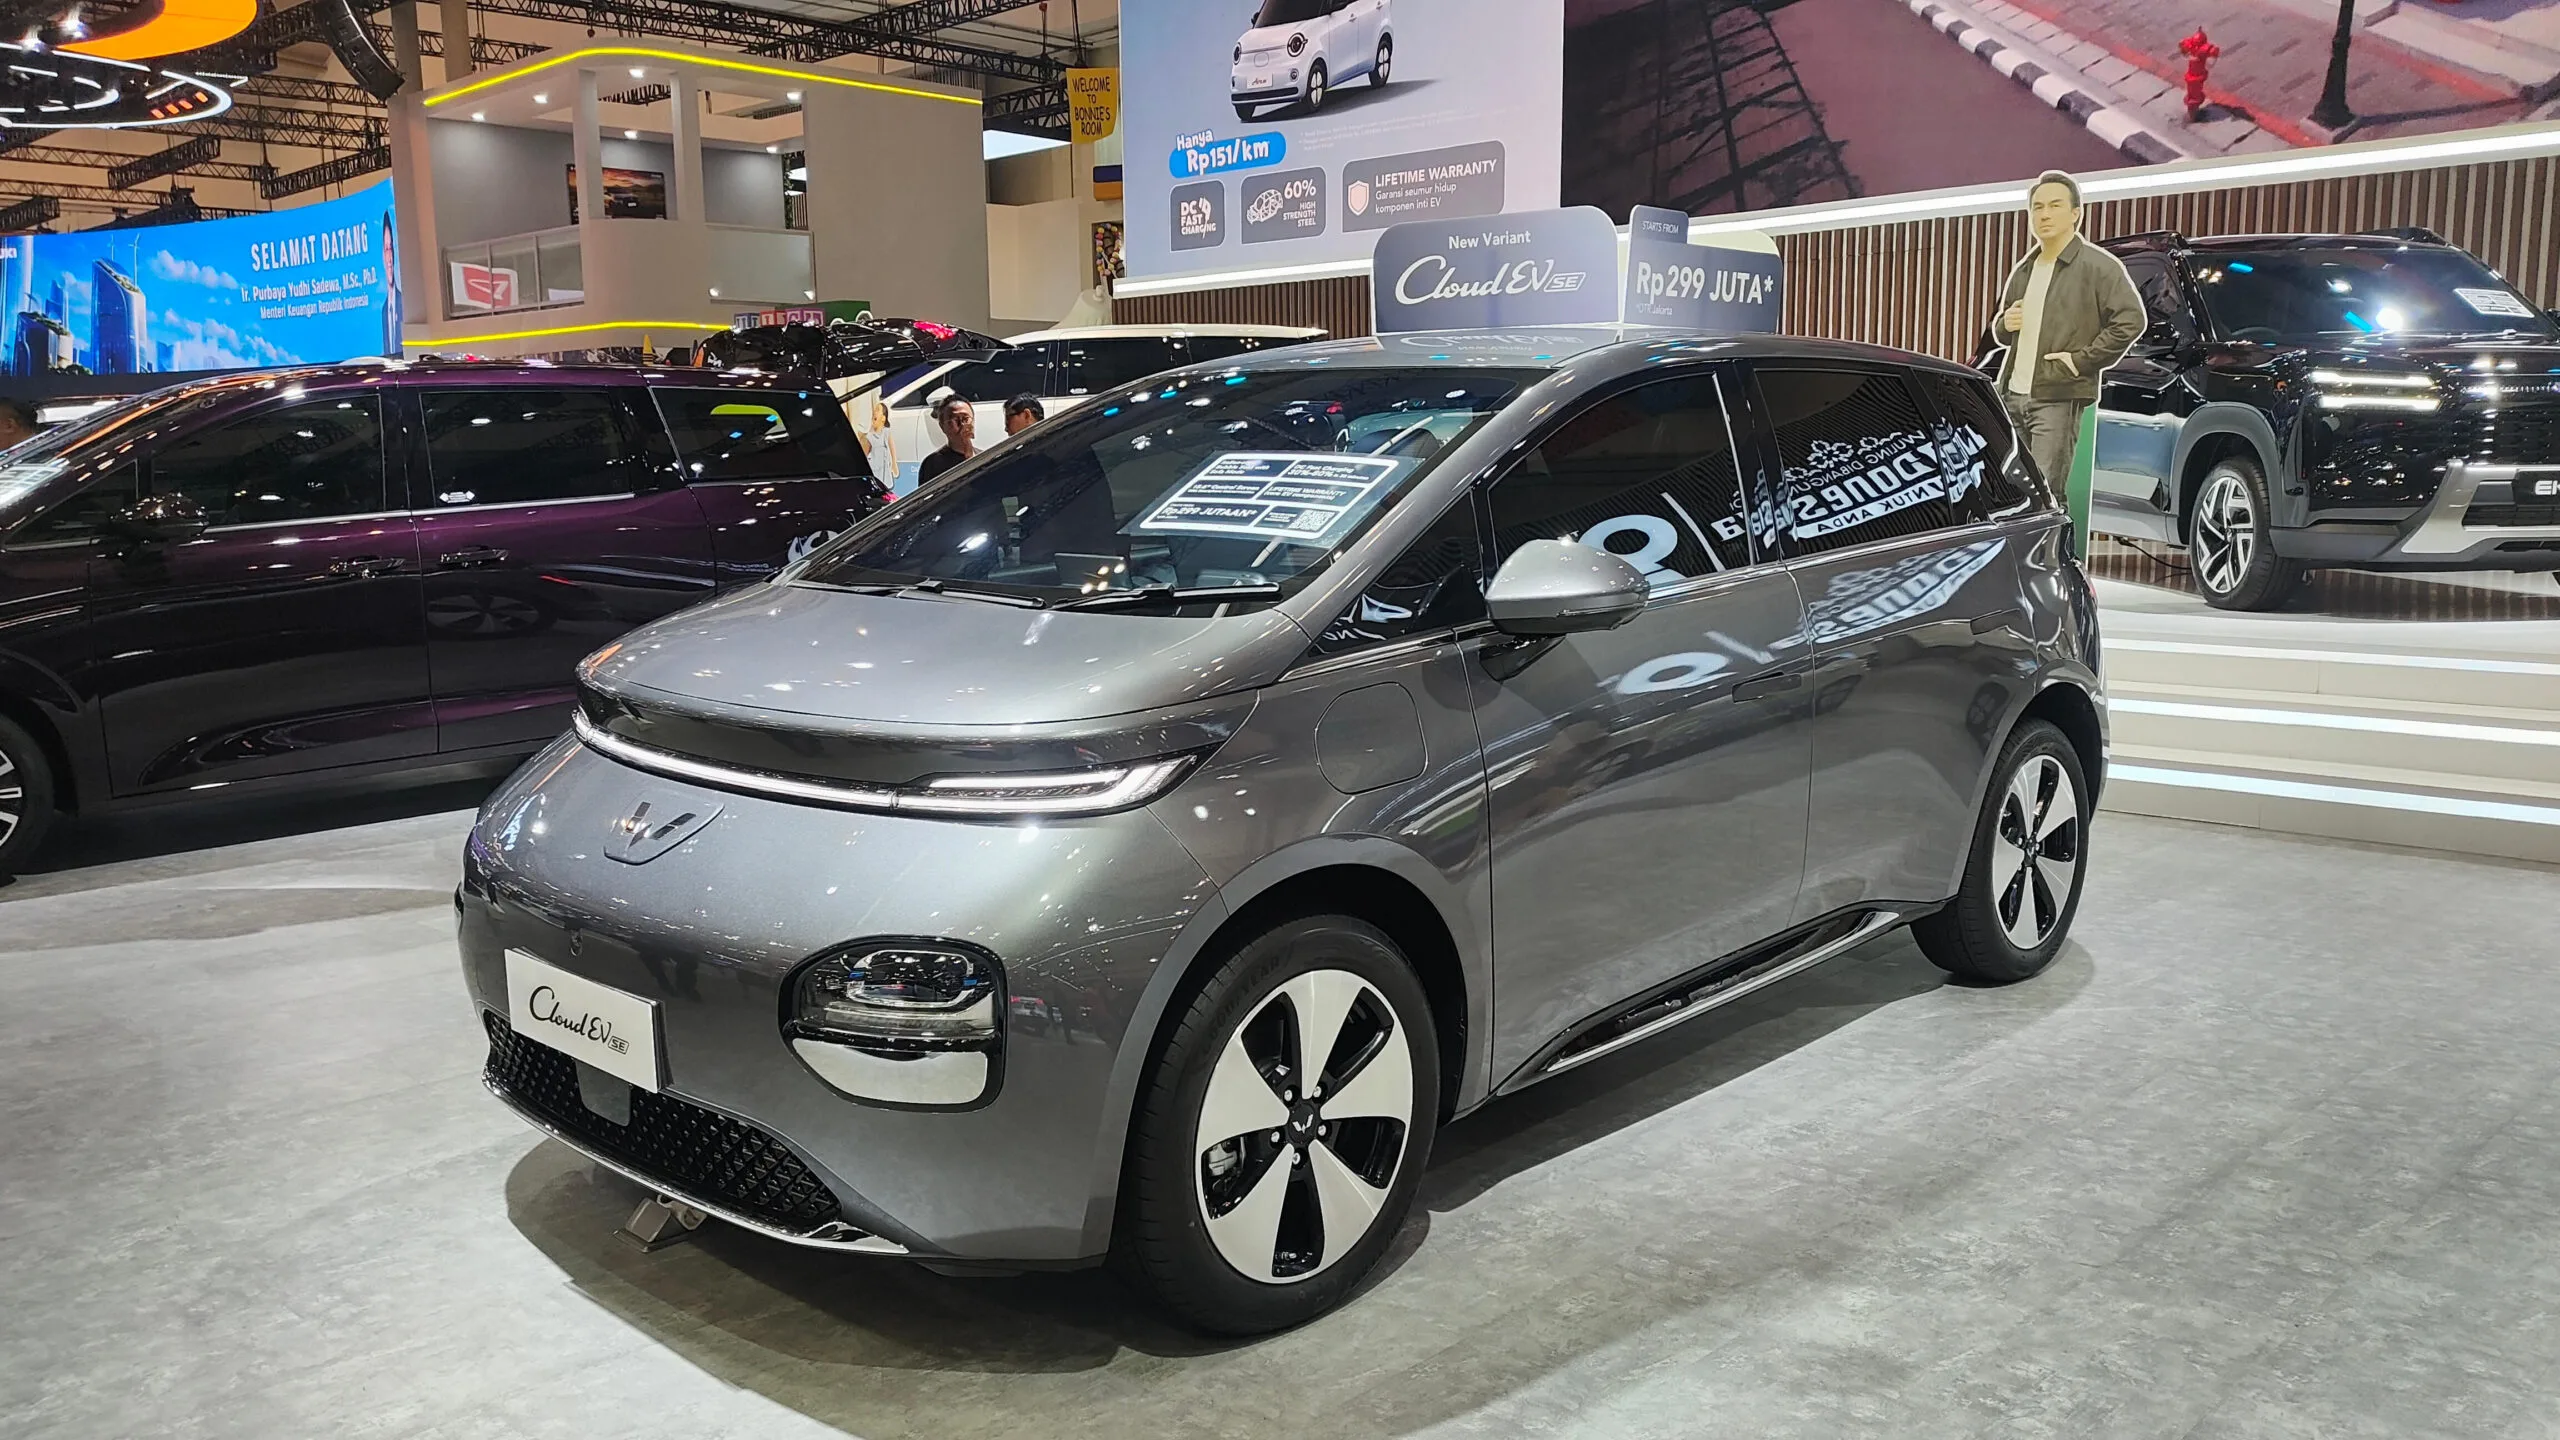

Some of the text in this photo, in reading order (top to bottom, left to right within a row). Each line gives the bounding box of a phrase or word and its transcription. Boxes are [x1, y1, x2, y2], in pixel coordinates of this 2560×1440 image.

[1072, 76, 1110, 92] WELCOME
[1087, 94, 1097, 103] TO
[1081, 122, 1103, 135] ROOM
[1176, 129, 1214, 150] Hanya
[1186, 139, 1270, 176] Rp151/km
[1375, 159, 1498, 188] LIFETIME WARRANTY
[1284, 179, 1317, 200] 60%
[1375, 182, 1457, 201] Garansi seumur hidup
[1180, 201, 1197, 215] DC
[1283, 208, 1317, 221] STRENGTH
[1299, 201, 1317, 211] HIGH
[1375, 197, 1442, 216] komponen inti EV
[1180, 213, 1203, 227] FAST
[1297, 218, 1317, 228] STEEL
[1642, 220, 1679, 234] STARTS FROM
[251, 222, 369, 272] SELAMAT DATANG
[1448, 230, 1531, 250] New Variant
[1395, 255, 1503, 305] Cloud
[1551, 274, 1581, 291] SE
[1636, 261, 1706, 305] Rp299
[241, 288, 250, 303] Ir.
[253, 283, 287, 302] Purbaya
[288, 279, 310, 297] Yudhi
[311, 277, 342, 294] Sadewa,
[260, 303, 285, 319] Menteri
[287, 302, 317, 318] Keuangan
[1652, 304, 1673, 316] Jakarta
[1302, 488, 1347, 497] WARRANTY
[529, 985, 628, 1053] Cloud EV SE
